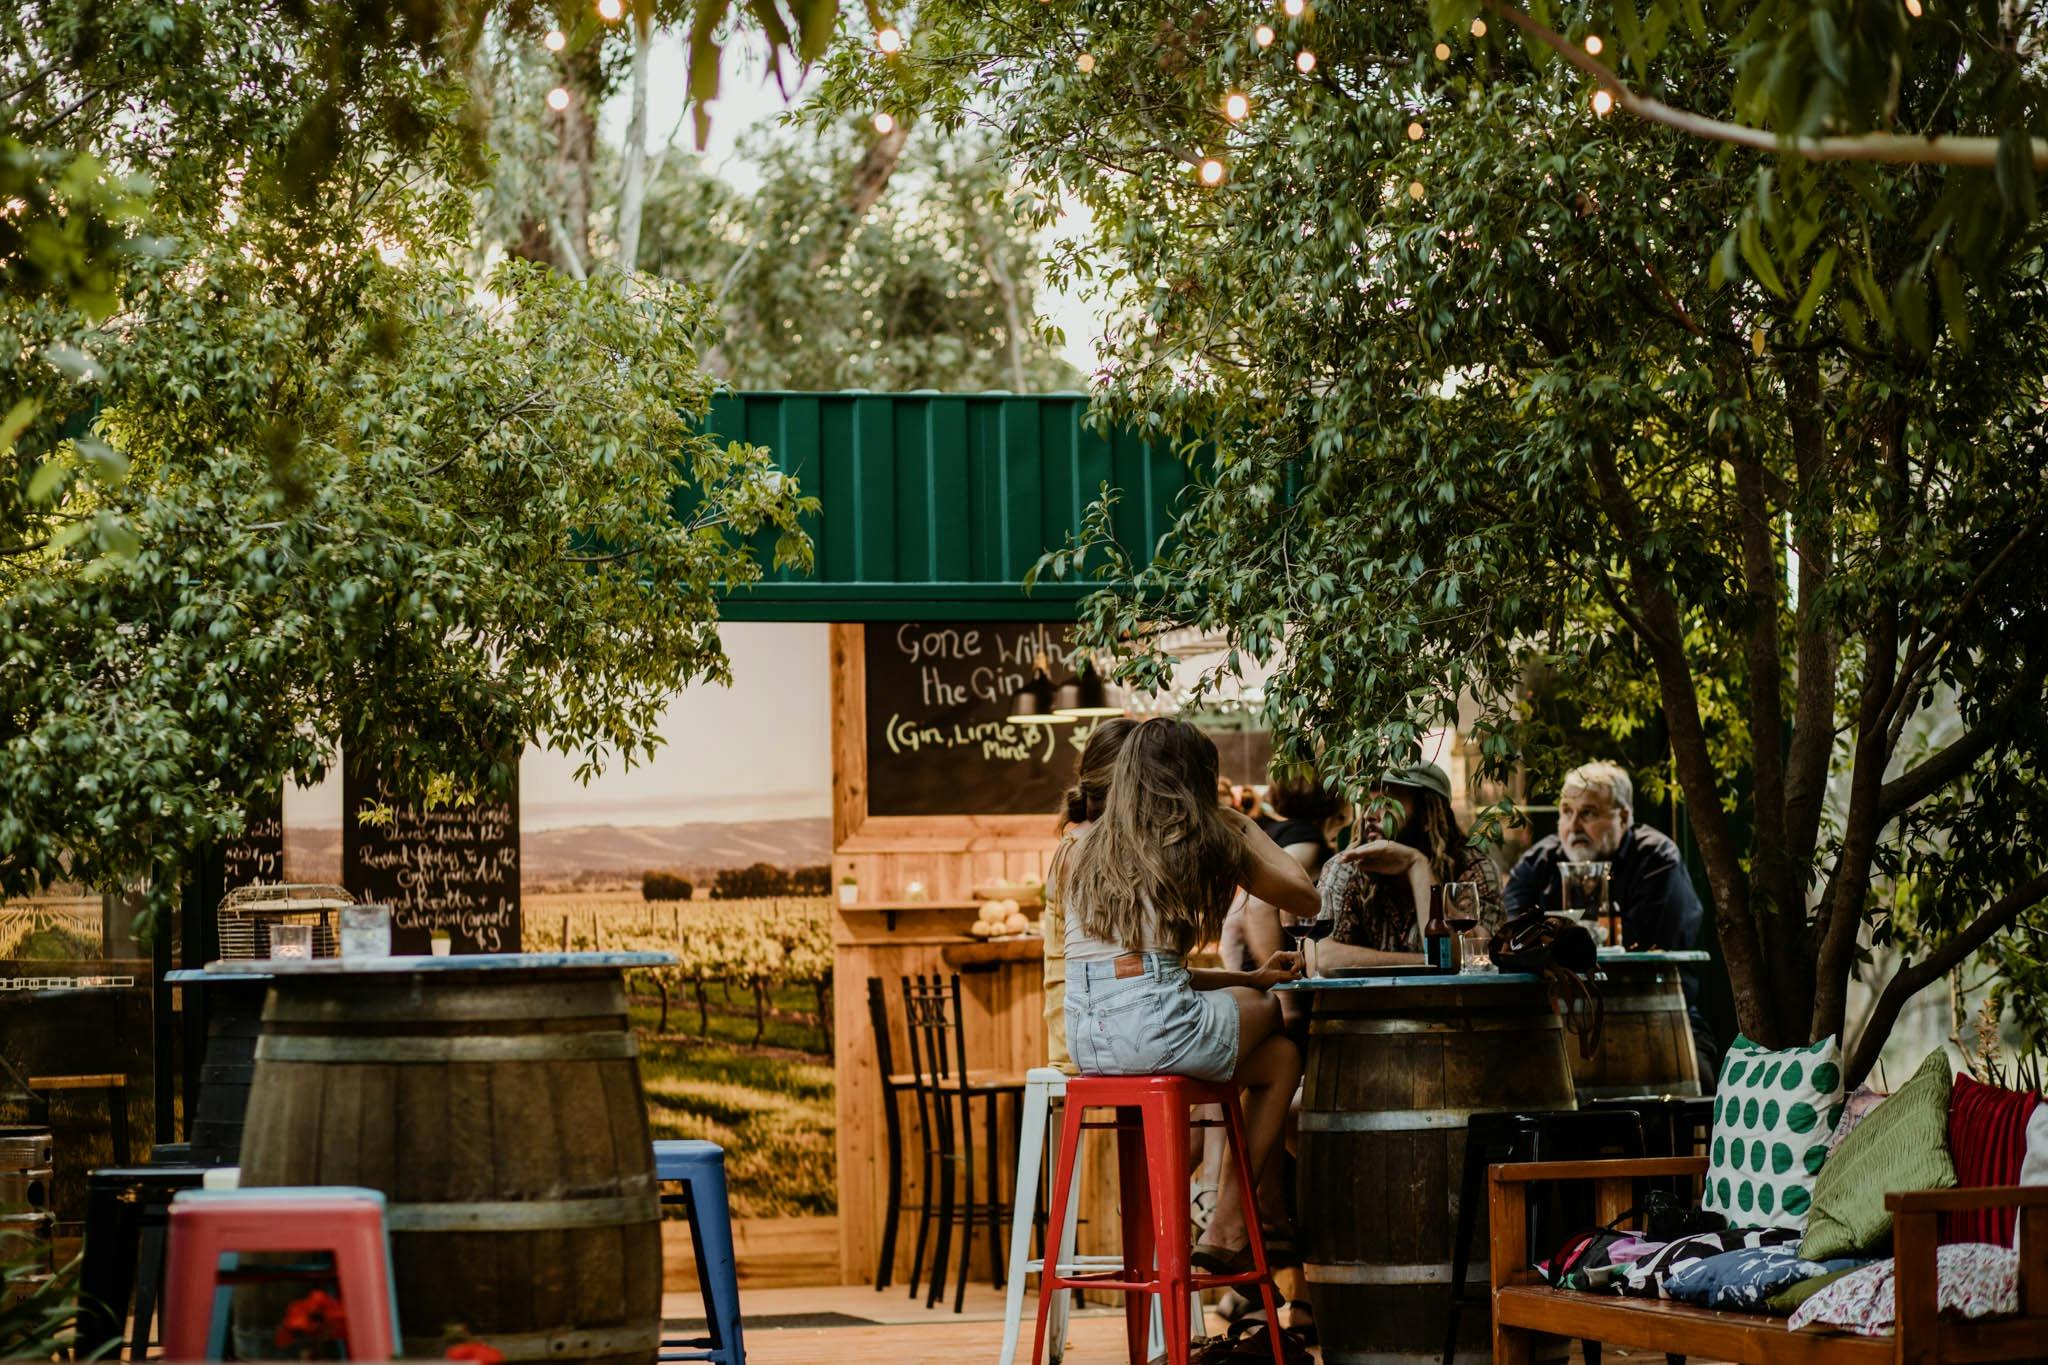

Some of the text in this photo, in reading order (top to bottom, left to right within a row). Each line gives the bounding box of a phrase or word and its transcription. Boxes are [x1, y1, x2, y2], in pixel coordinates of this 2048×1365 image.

[897, 624, 982, 663] Gone
[922, 666, 1024, 706] the Gin
[955, 722, 1017, 746] Lime
